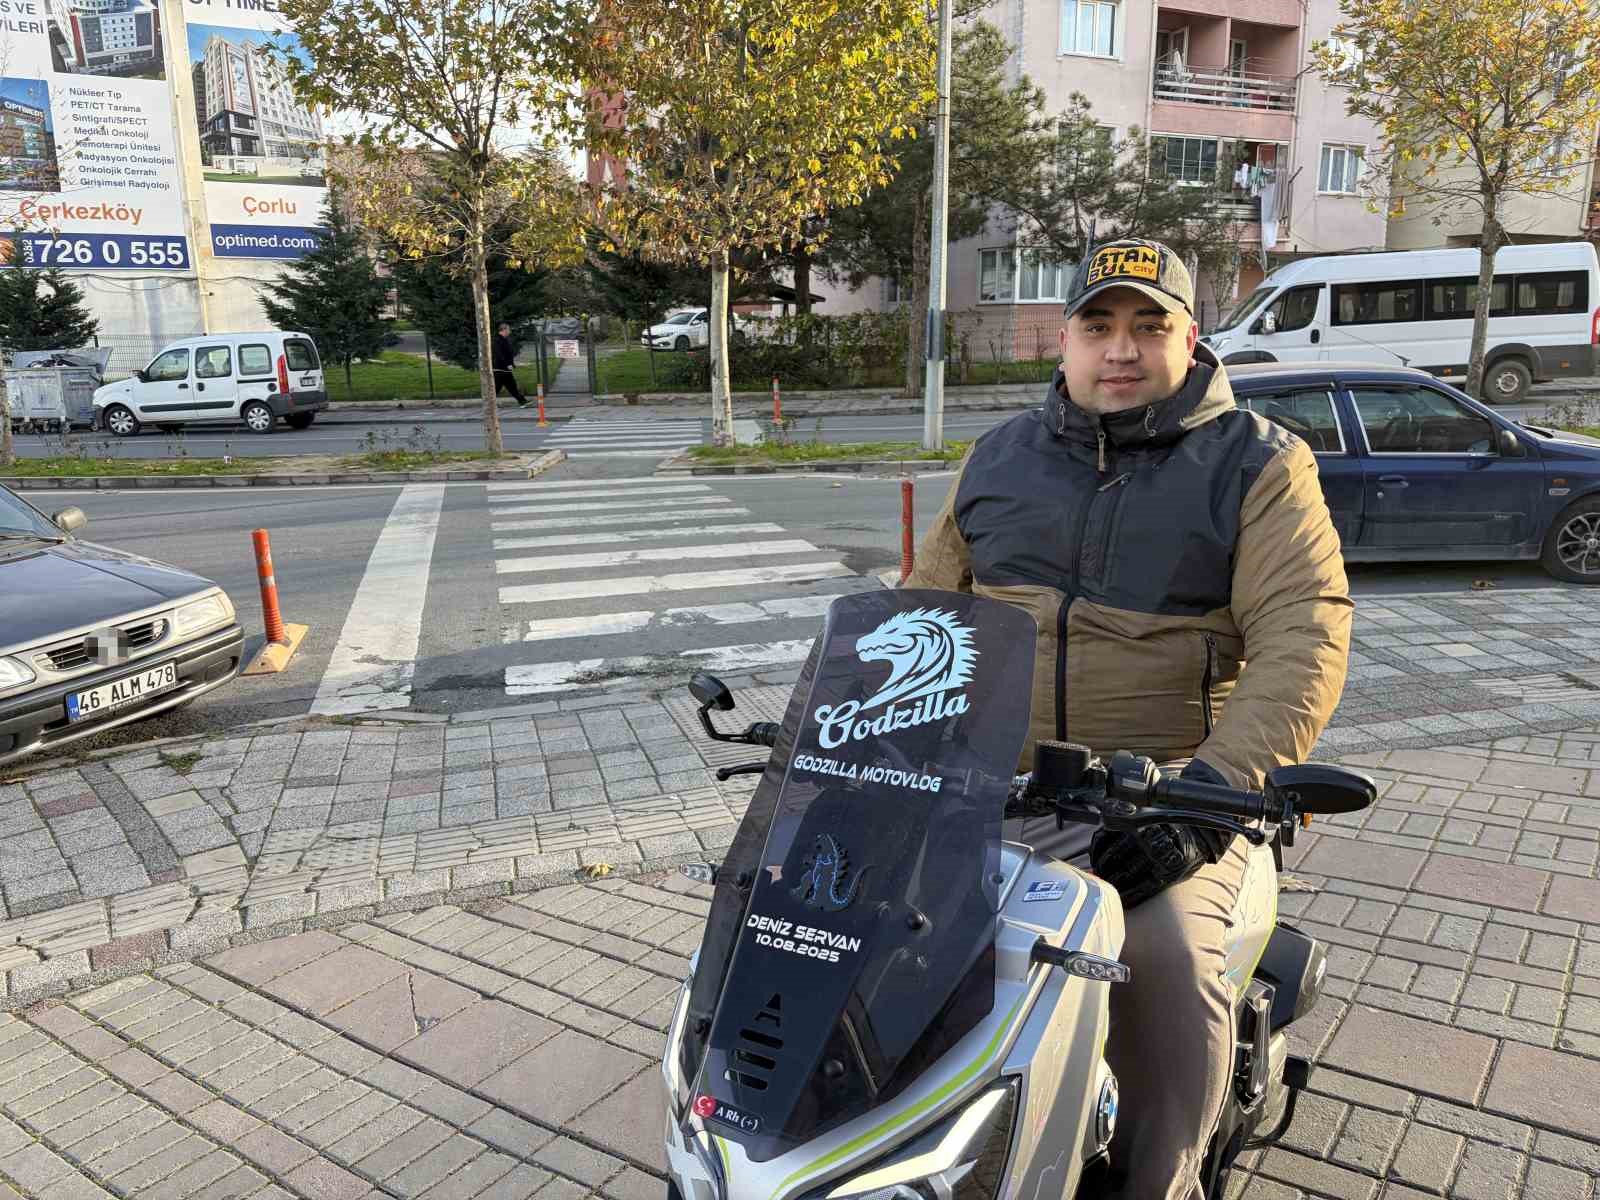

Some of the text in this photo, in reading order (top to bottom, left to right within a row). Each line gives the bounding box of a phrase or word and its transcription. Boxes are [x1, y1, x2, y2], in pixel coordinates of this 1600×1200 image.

[14, 2, 36, 15] VE
[0, 16, 44, 34] İLERİ
[69, 87, 104, 98] Nükleer
[70, 100, 141, 113] PET/CT Tarama
[72, 113, 148, 126] Sintigrafi/SPECT
[74, 126, 149, 140] Medikal Onkoloji
[130, 140, 161, 152] Ünitesi
[130, 155, 175, 166] Onkolojisi
[78, 165, 122, 177] Onkolojik
[80, 177, 170, 191] Girişimsel Radyoloji
[242, 196, 297, 217] Çorlu
[34, 239, 93, 264] 726
[102, 240, 121, 264] 0
[130, 241, 184, 265] 555
[79, 690, 100, 712] 46
[111, 676, 141, 703] ALM
[146, 665, 174, 689] 478
[814, 691, 970, 749] Godzilla
[793, 754, 943, 793] GODZILLA MOTOVLOG
[746, 913, 861, 953] DENİZ SERVAN
[755, 932, 841, 963] 10.08.2025
[714, 1106, 724, 1117] A
[725, 1109, 739, 1123] Rh
